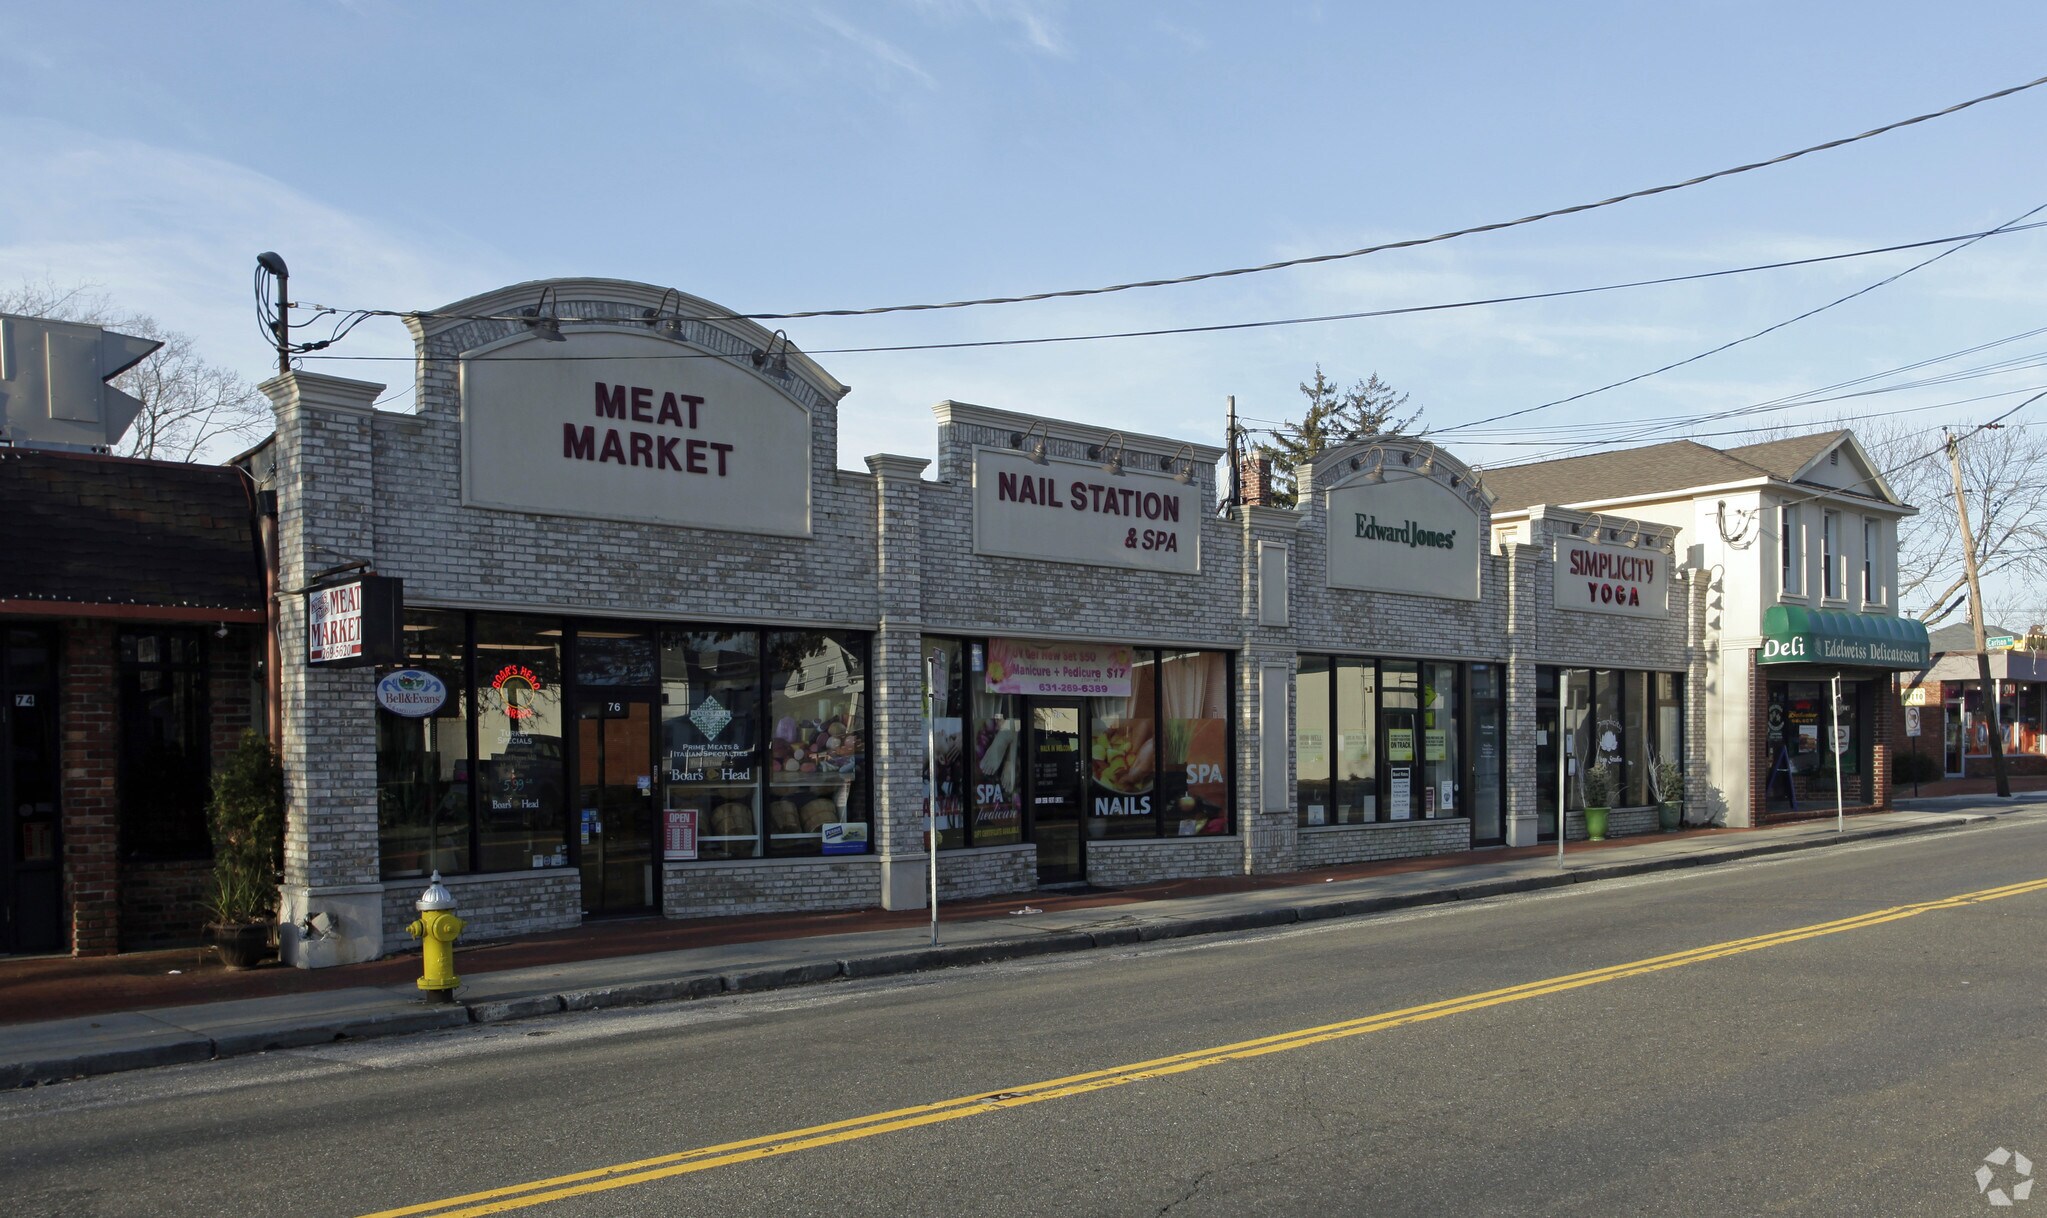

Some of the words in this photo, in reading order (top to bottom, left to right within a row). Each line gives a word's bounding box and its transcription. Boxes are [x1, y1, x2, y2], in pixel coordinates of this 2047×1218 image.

[595, 381, 705, 429] MEAT
[563, 422, 734, 477] MARKET
[998, 471, 1063, 508] NAIL
[1070, 481, 1179, 523] STATION
[1124, 527, 1138, 549] &
[1141, 529, 1178, 552] SPA
[1570, 549, 1653, 584] SIMPLICITY
[330, 586, 361, 615] MEAT
[1588, 582, 1640, 607] YOGA
[311, 616, 361, 648] MARKET
[1025, 649, 1039, 660] Gel
[1063, 651, 1077, 661] Set
[1763, 636, 1805, 658] Deli
[1824, 639, 1867, 660] Edelweiss
[1870, 641, 1920, 663] Delicatessen
[492, 664, 518, 689] BOAR'S
[520, 665, 541, 690] HEAD
[1012, 663, 1051, 677] Manicure
[1054, 669, 1060, 677] +
[1063, 666, 1101, 679] Pedicure
[1106, 668, 1126, 679] $17
[1039, 683, 1108, 693] 631-269-6389
[1903, 693, 1924, 701] LOTTO
[17, 695, 34, 706] 74
[608, 702, 621, 712] 76
[497, 736, 533, 745] SPECIALS
[500, 729, 529, 737] TURKEY
[672, 768, 704, 781] Boar's
[721, 767, 750, 781] Head
[1186, 764, 1224, 784] SPA
[492, 799, 512, 809] Boar's
[521, 798, 539, 809] Head
[976, 783, 1004, 804] SPA
[975, 802, 1018, 825] pedicure
[1095, 796, 1151, 816] NAILS
[669, 812, 690, 823] OPEN
